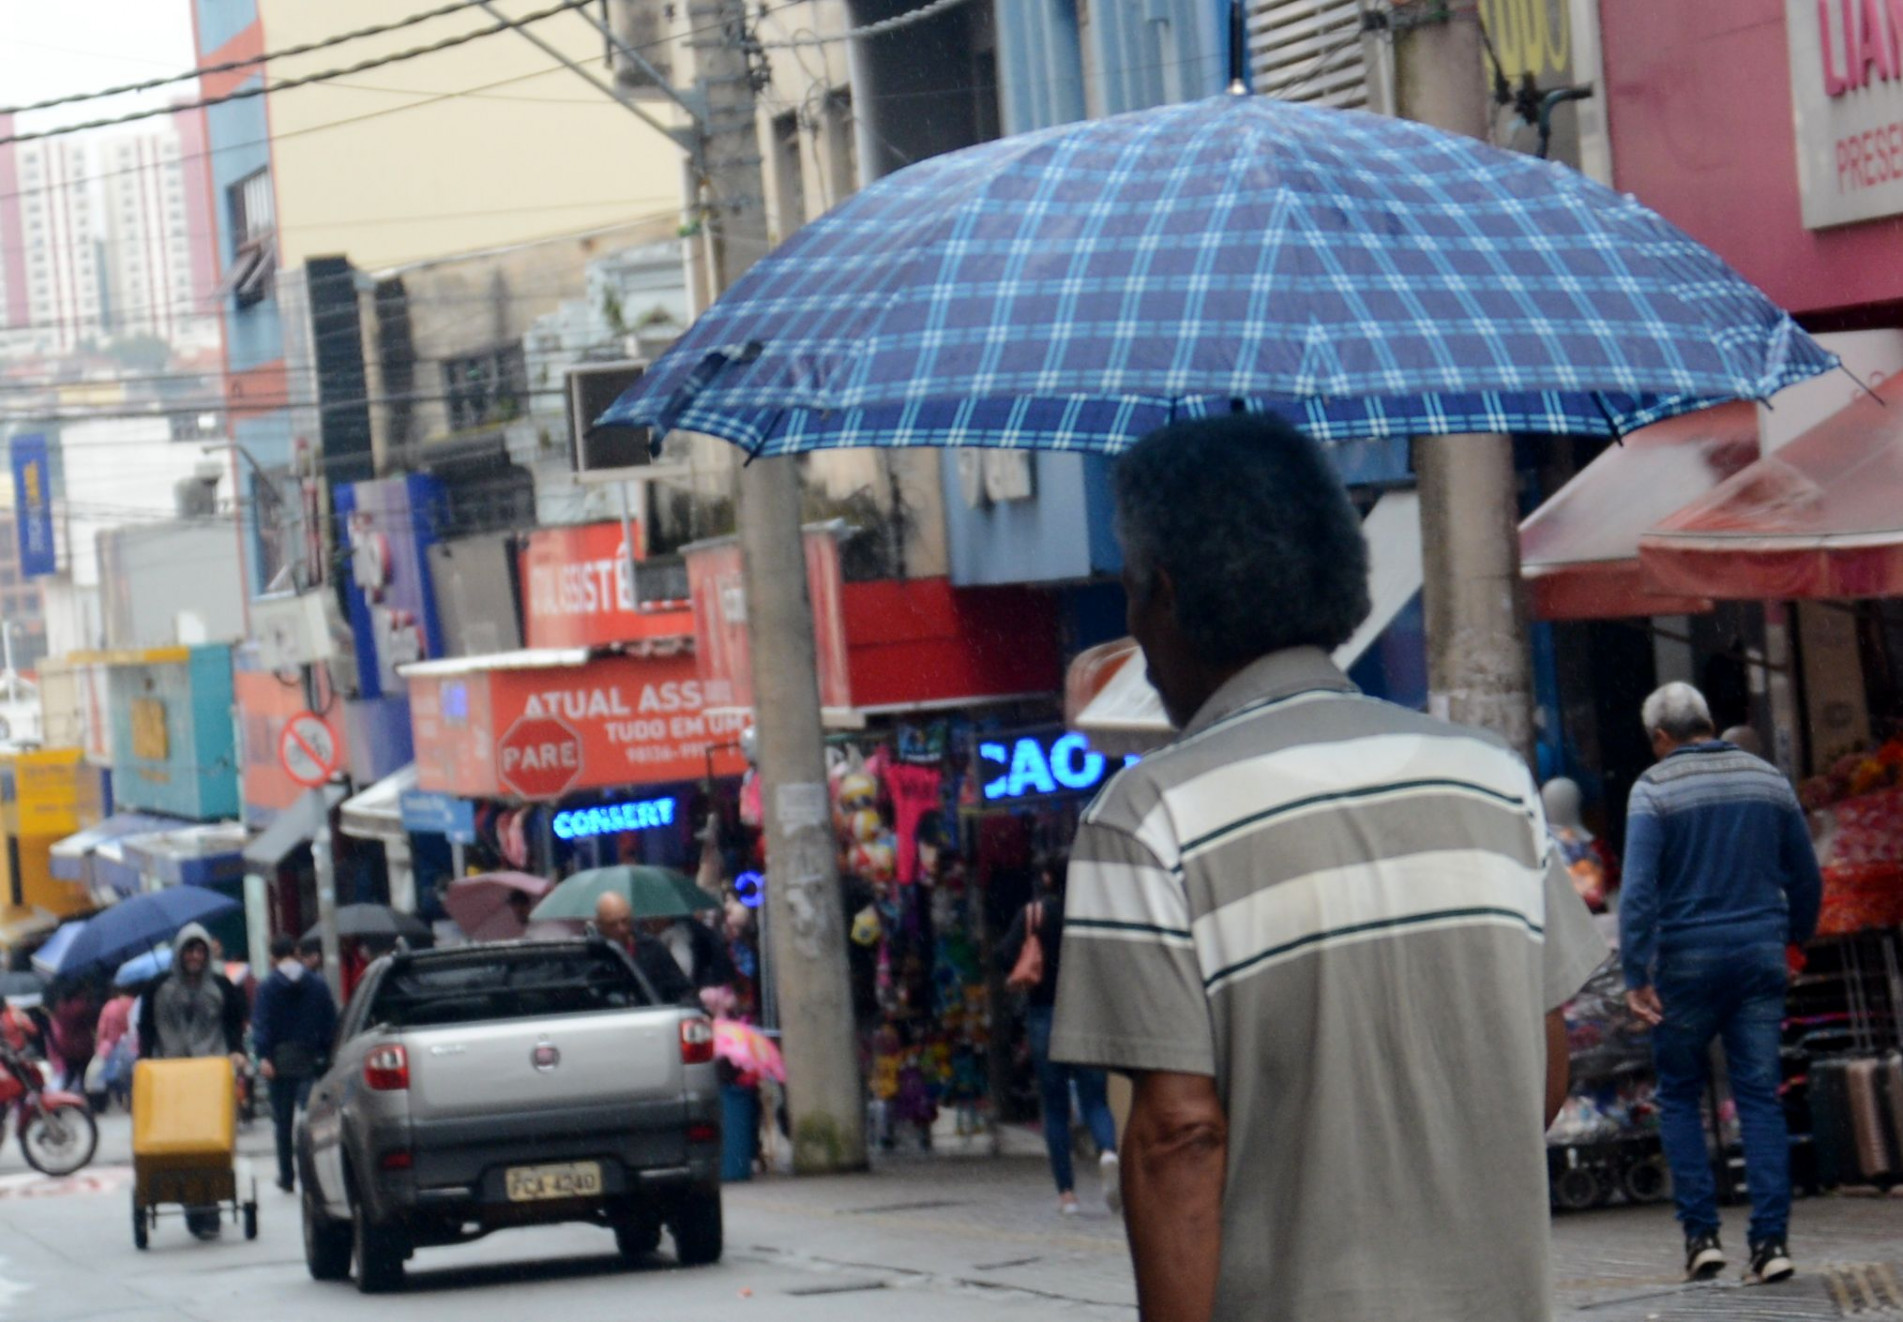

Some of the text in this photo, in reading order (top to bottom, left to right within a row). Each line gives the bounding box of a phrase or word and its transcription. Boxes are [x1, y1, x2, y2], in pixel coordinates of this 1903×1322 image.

[524, 679, 734, 720] ATUAL ASS
[605, 720, 666, 743] TUDO
[668, 717, 705, 739] EM
[502, 742, 577, 771] PARE
